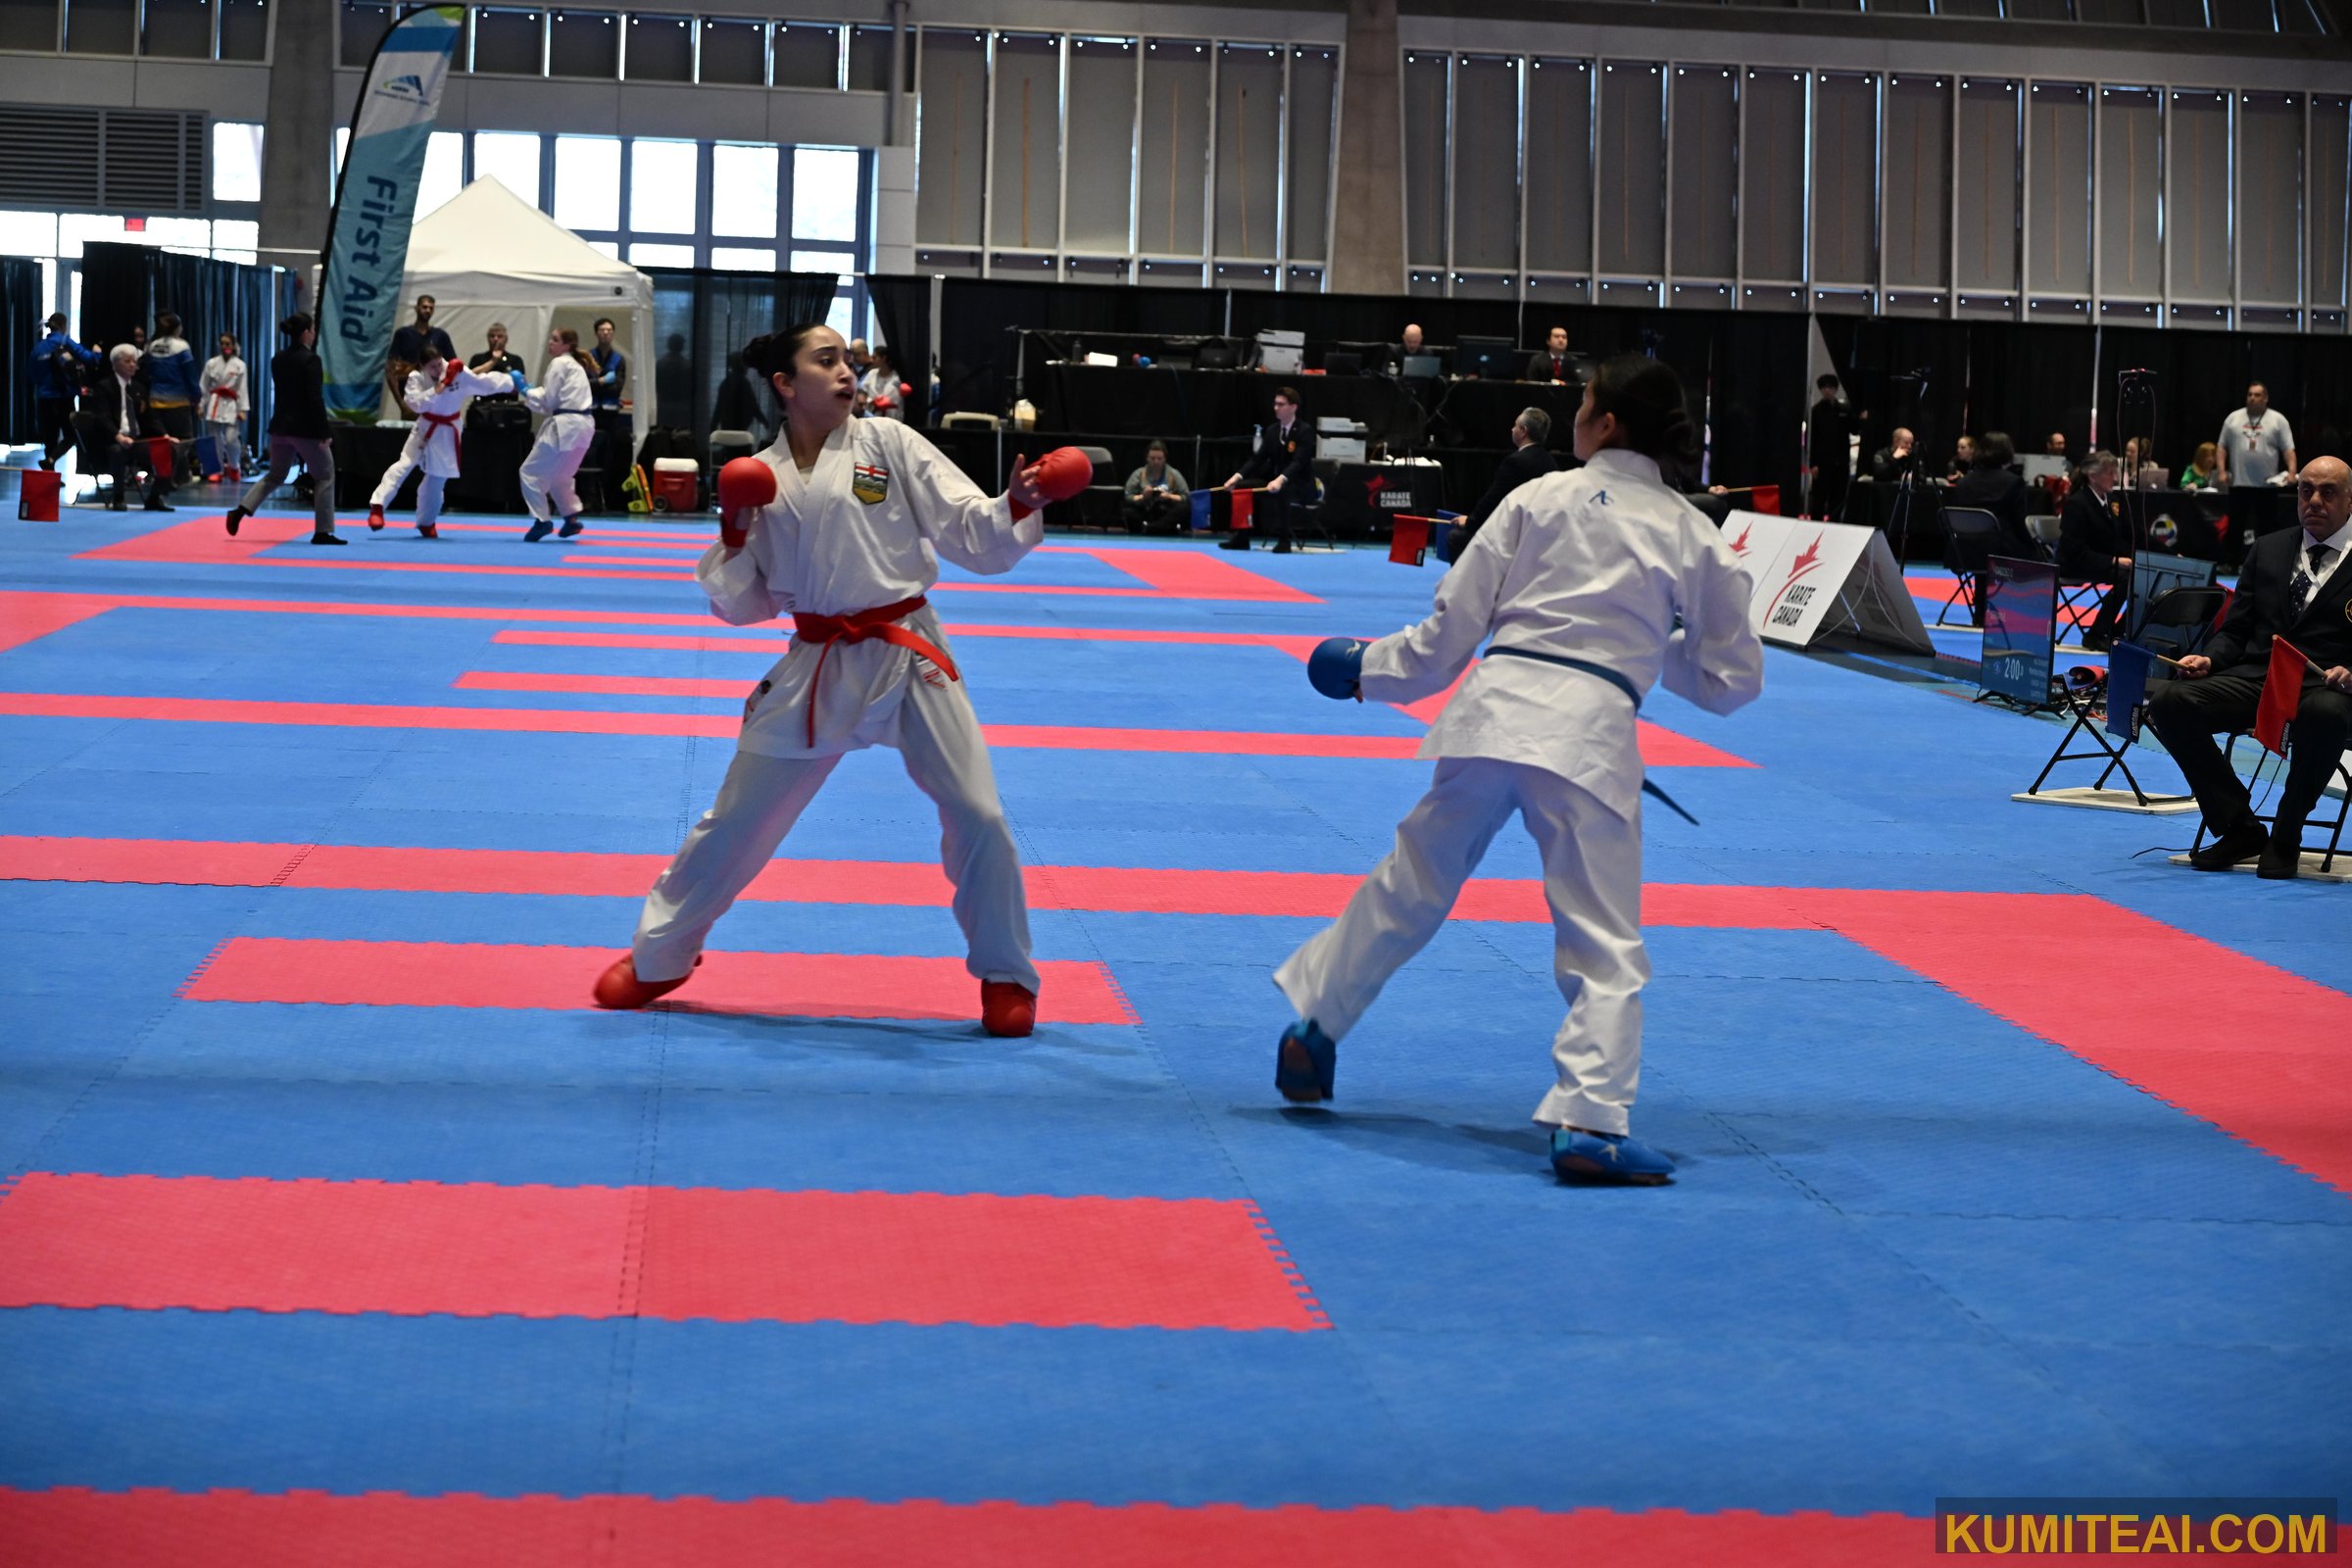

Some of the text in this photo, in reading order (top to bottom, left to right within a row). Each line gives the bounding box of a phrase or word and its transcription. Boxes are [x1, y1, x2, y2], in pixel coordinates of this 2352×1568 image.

[340, 175, 398, 343] First Aid
[1380, 499, 1412, 508] CANADA
[1785, 584, 1816, 606] KARATE
[1772, 606, 1803, 627] CANADA
